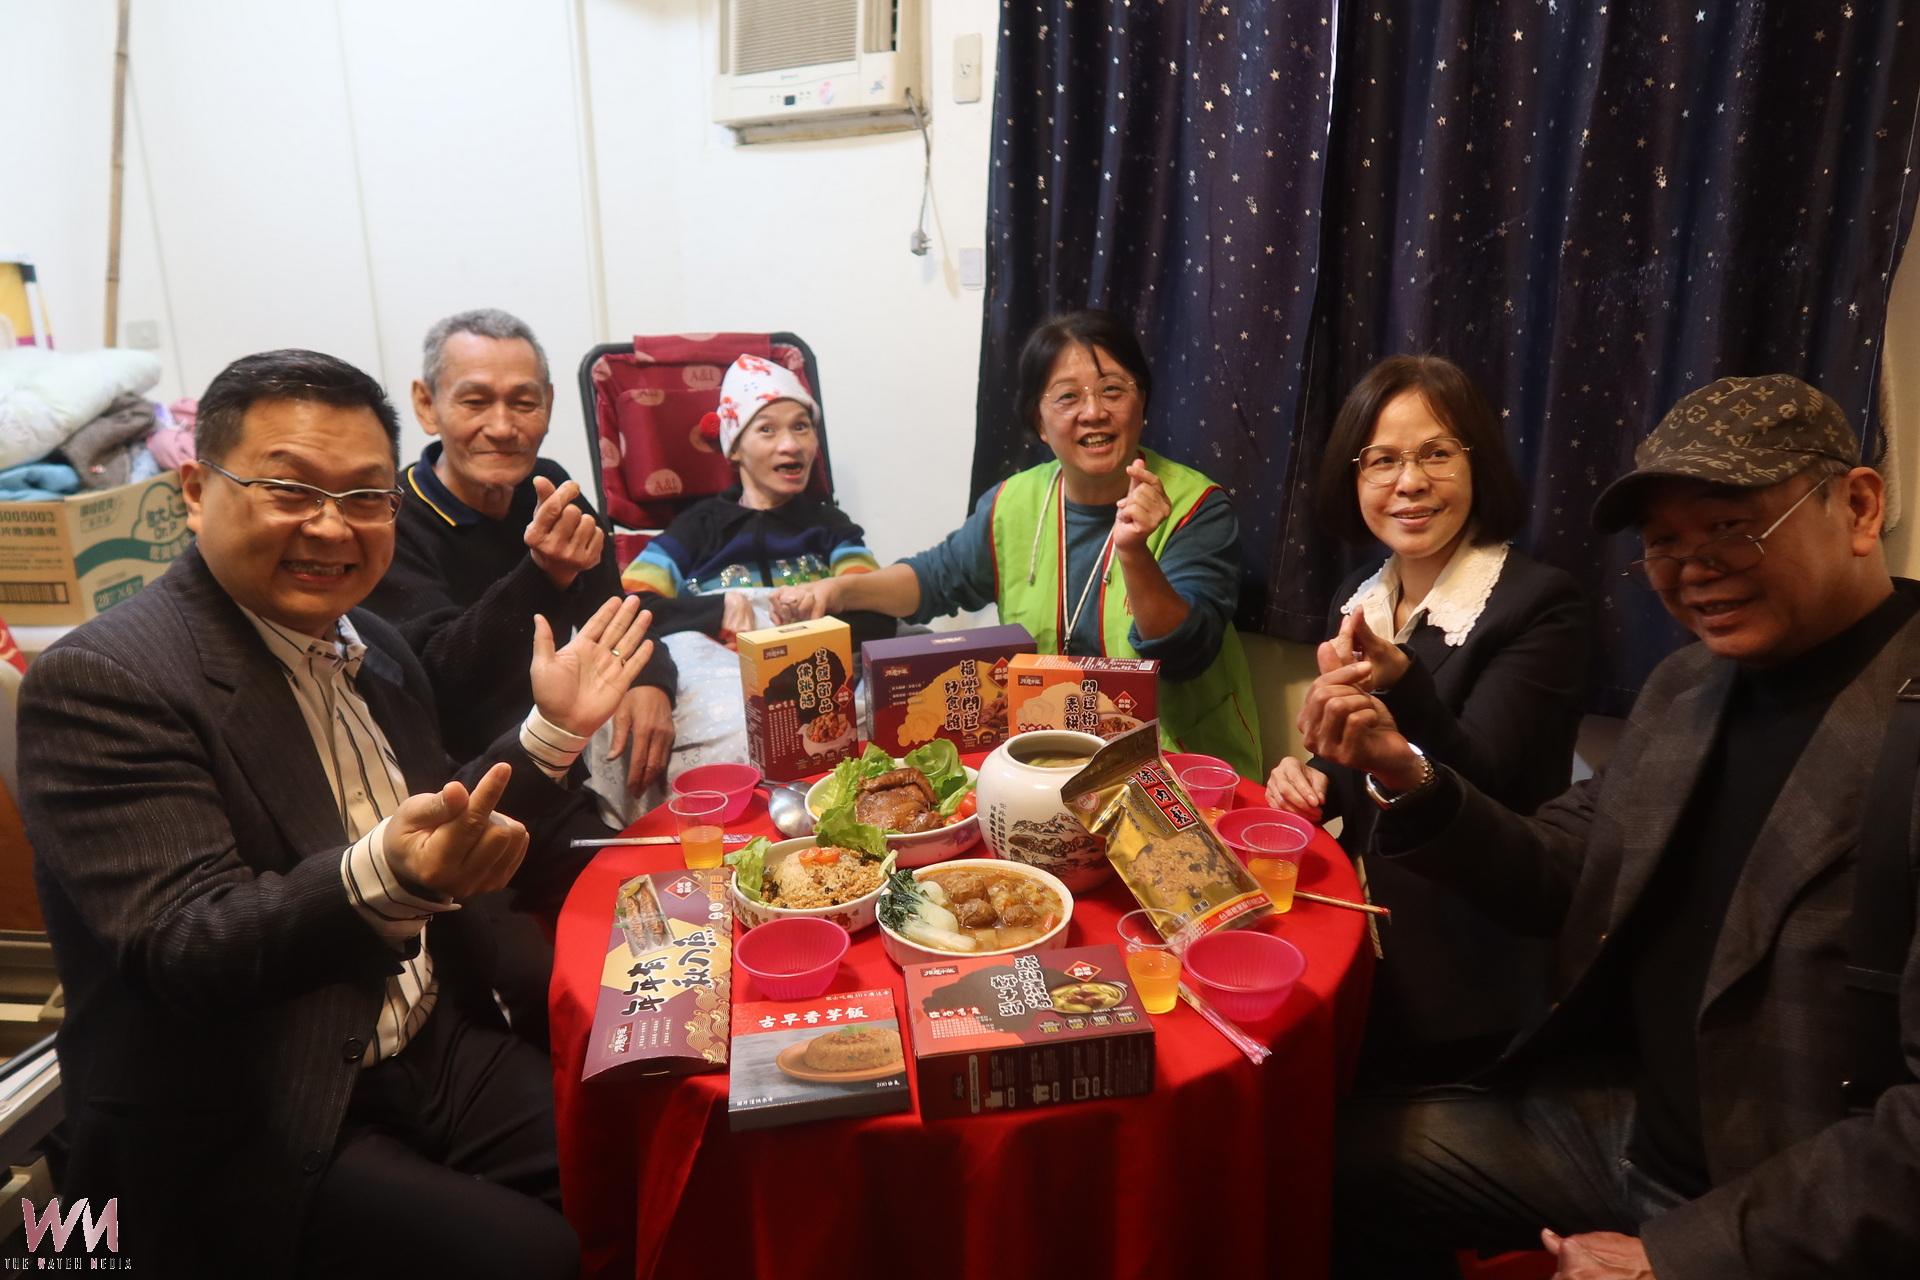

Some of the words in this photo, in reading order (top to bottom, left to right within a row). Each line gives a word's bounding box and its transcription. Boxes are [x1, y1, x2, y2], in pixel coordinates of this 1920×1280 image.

[960, 659, 980, 731] 福樂開運
[671, 927, 718, 989] 秋刀魚
[758, 1006, 870, 1029] 古早香芋飯
